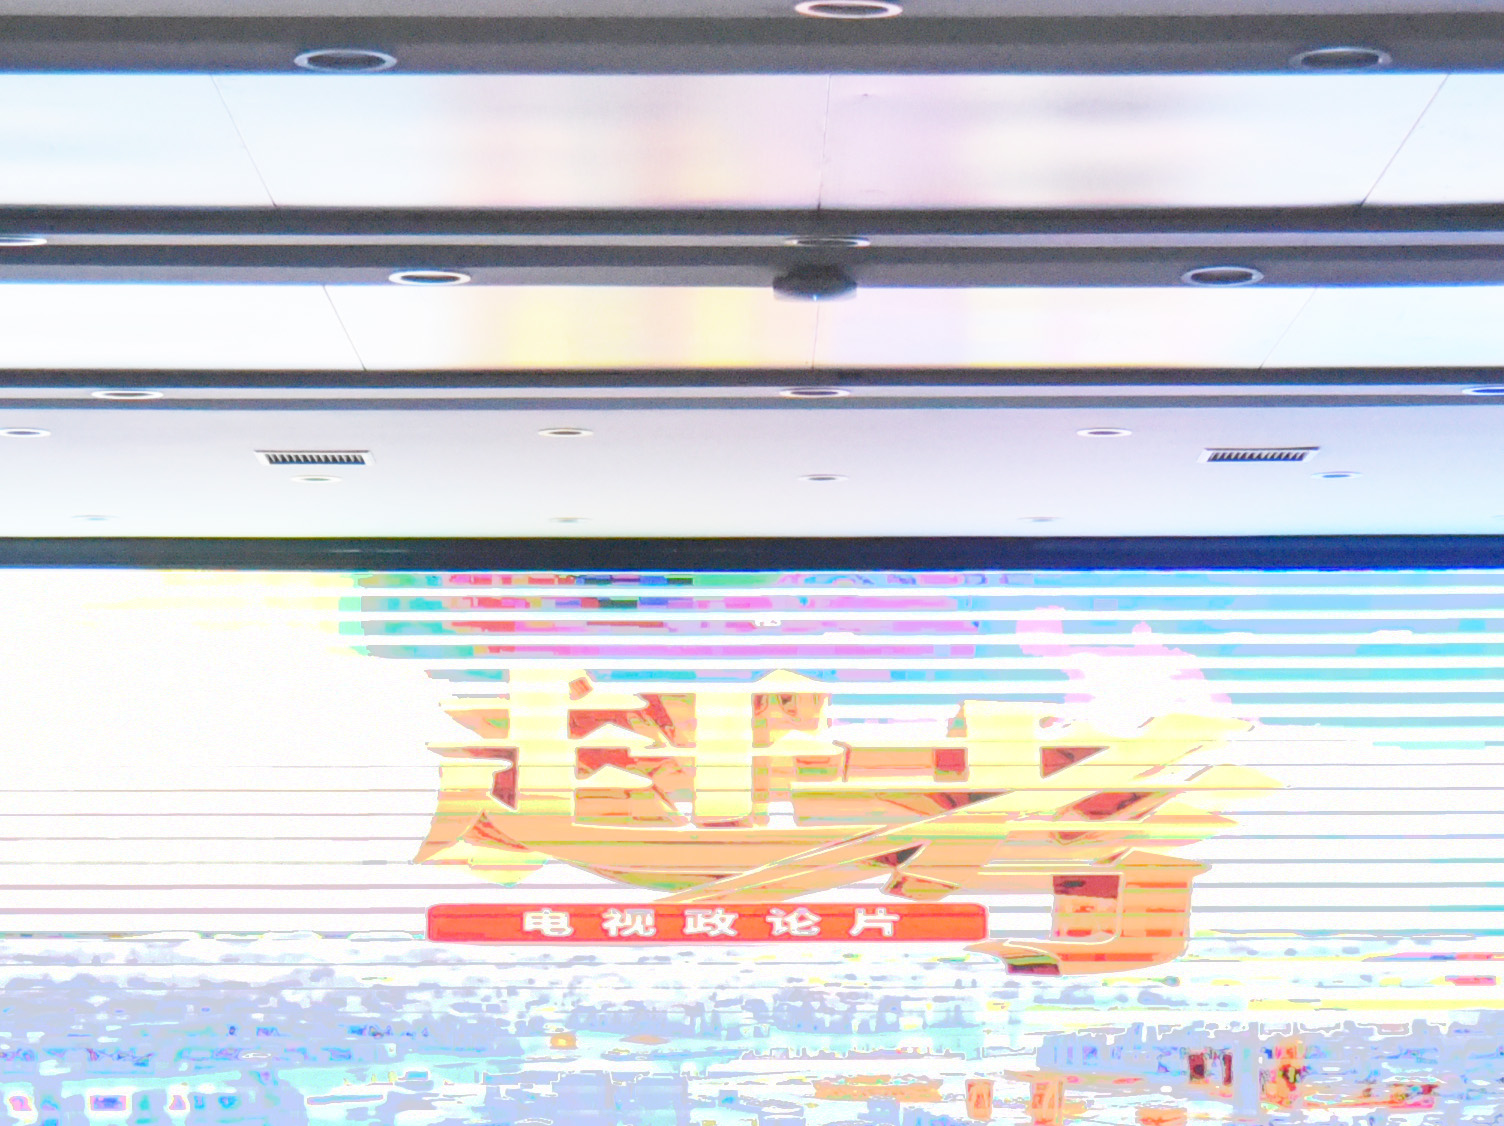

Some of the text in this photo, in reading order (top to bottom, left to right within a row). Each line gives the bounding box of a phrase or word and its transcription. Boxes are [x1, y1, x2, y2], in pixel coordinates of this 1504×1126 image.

[413, 668, 1291, 976] 赶考
[521, 907, 902, 938] 电视政论片
